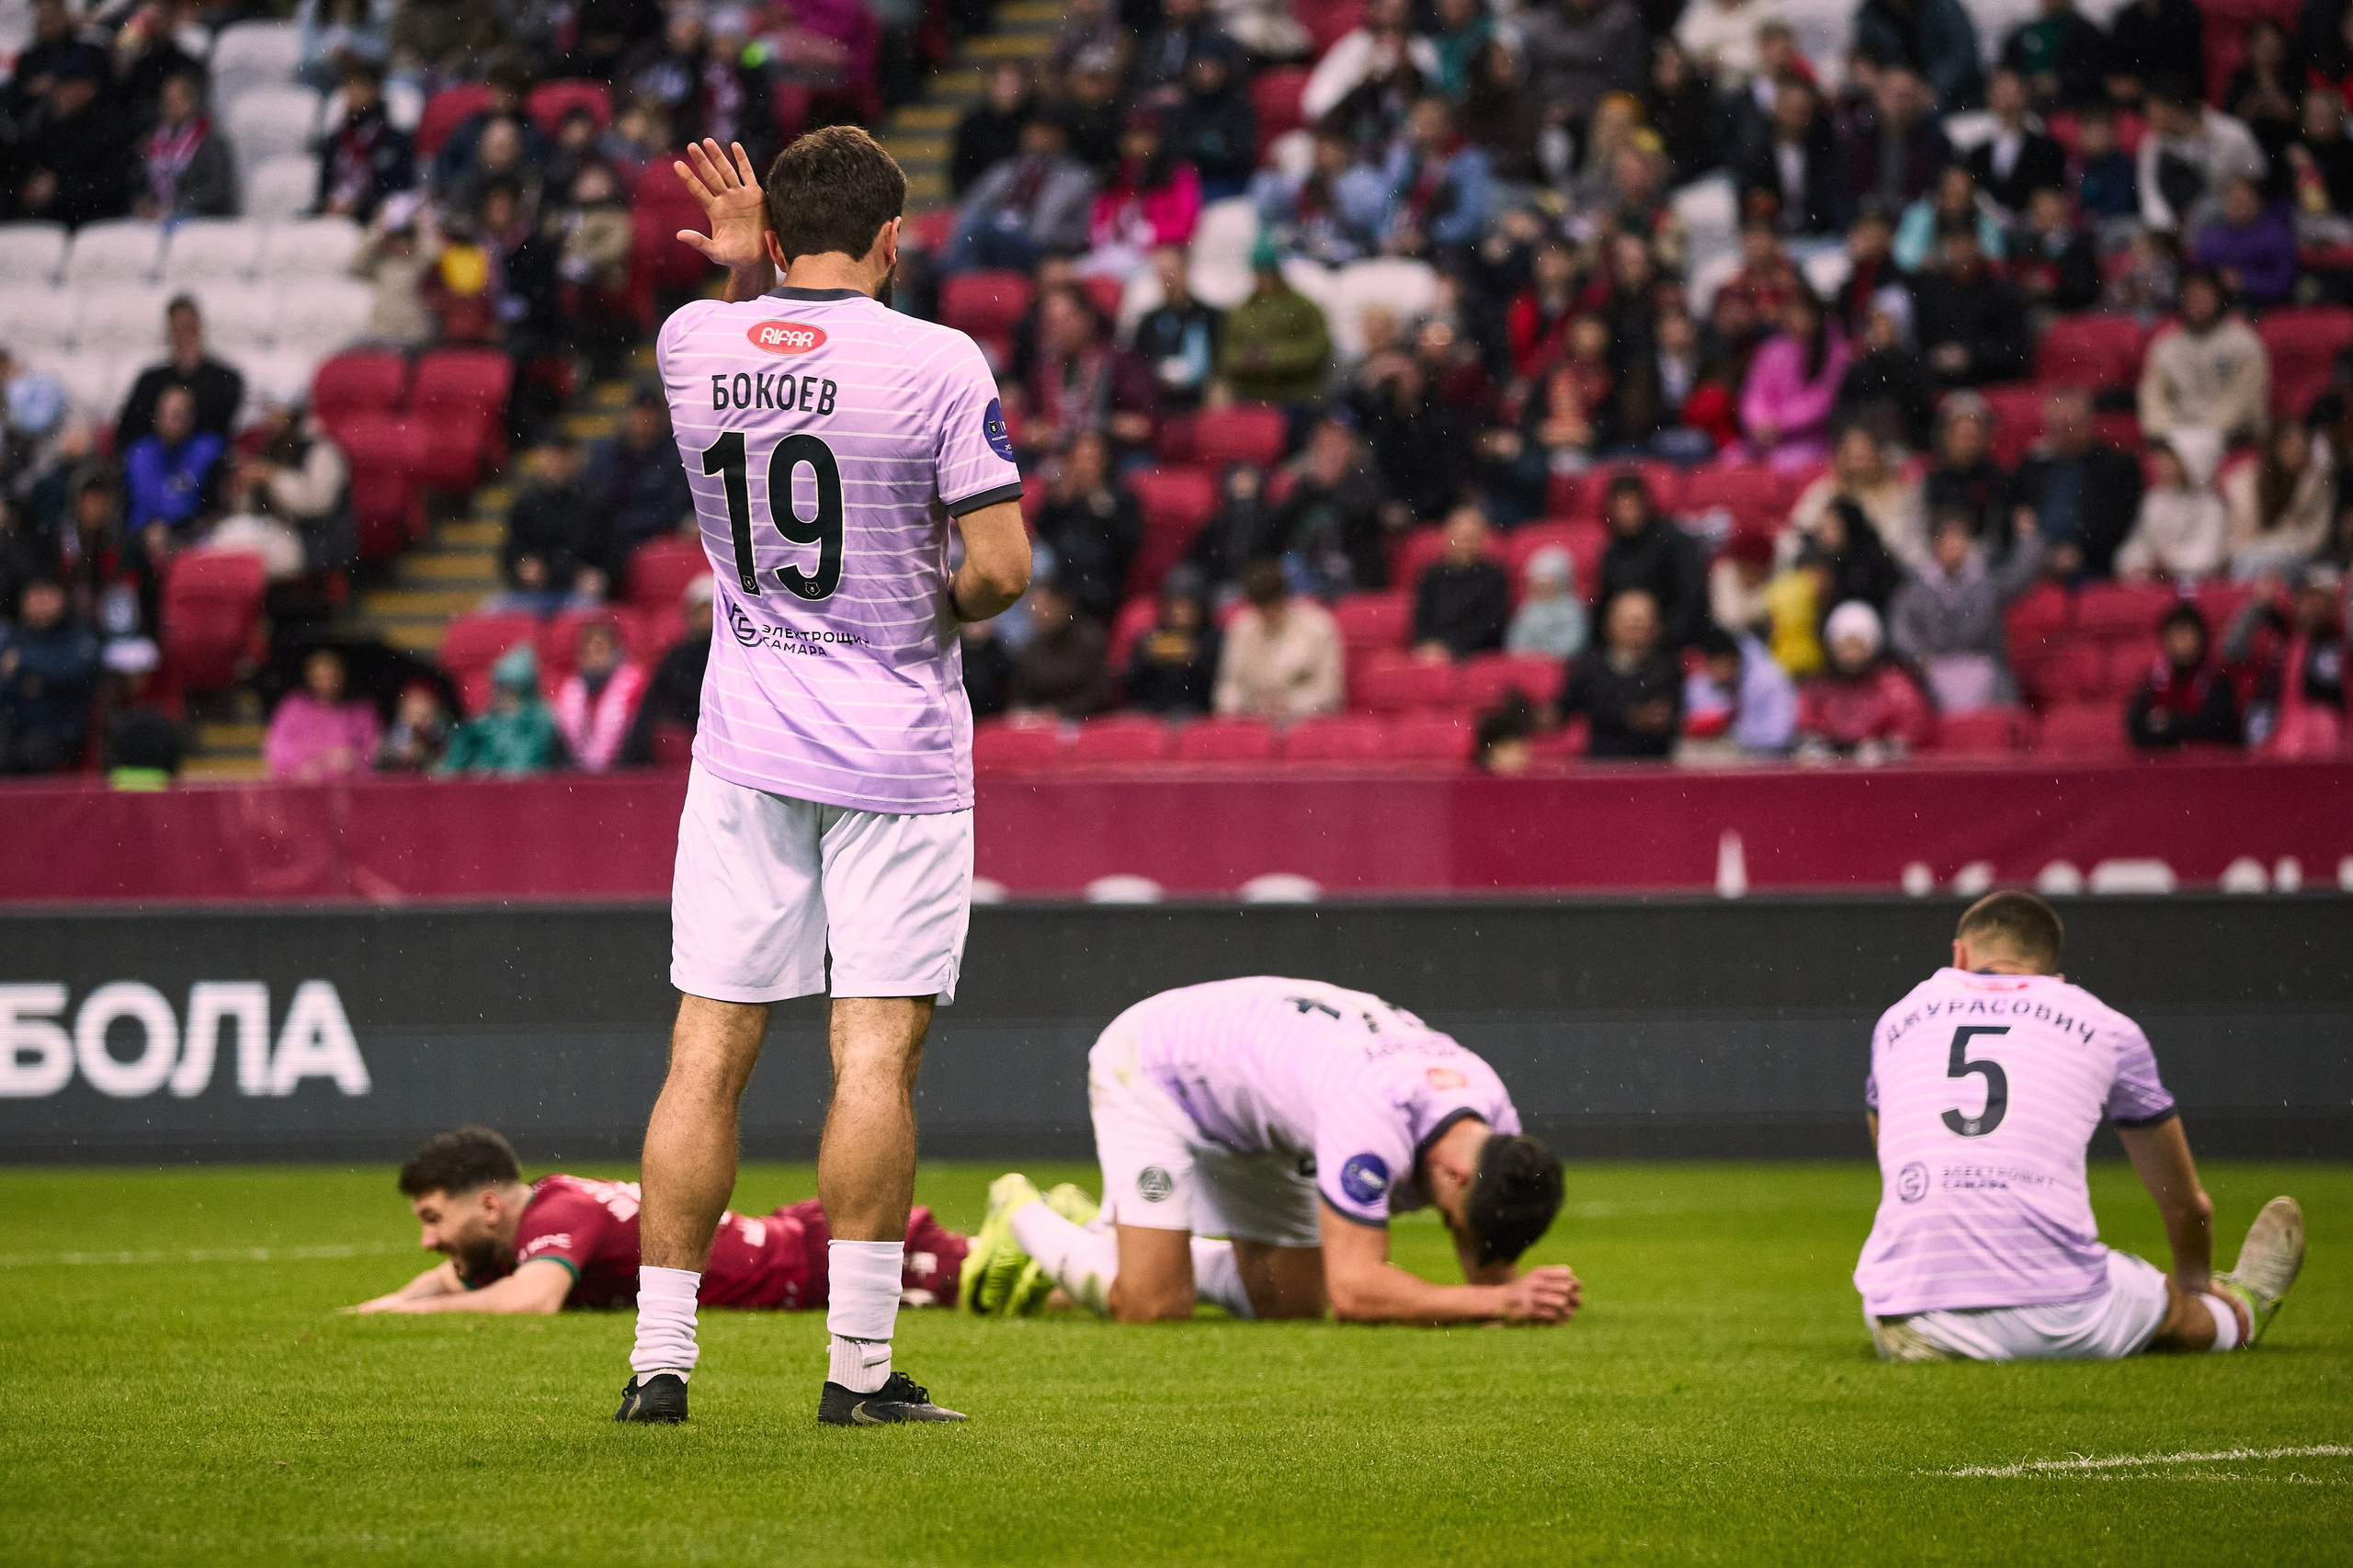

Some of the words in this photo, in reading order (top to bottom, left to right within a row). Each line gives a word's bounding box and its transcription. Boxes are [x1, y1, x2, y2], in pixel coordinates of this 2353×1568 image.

[759, 326, 815, 347] RIFAR
[711, 372, 837, 415] БОКОЕВ
[701, 431, 845, 602] 19
[763, 636, 827, 656] САМАРА
[0, 977, 373, 1099] БОЛА
[1940, 1024, 2013, 1139] 5
